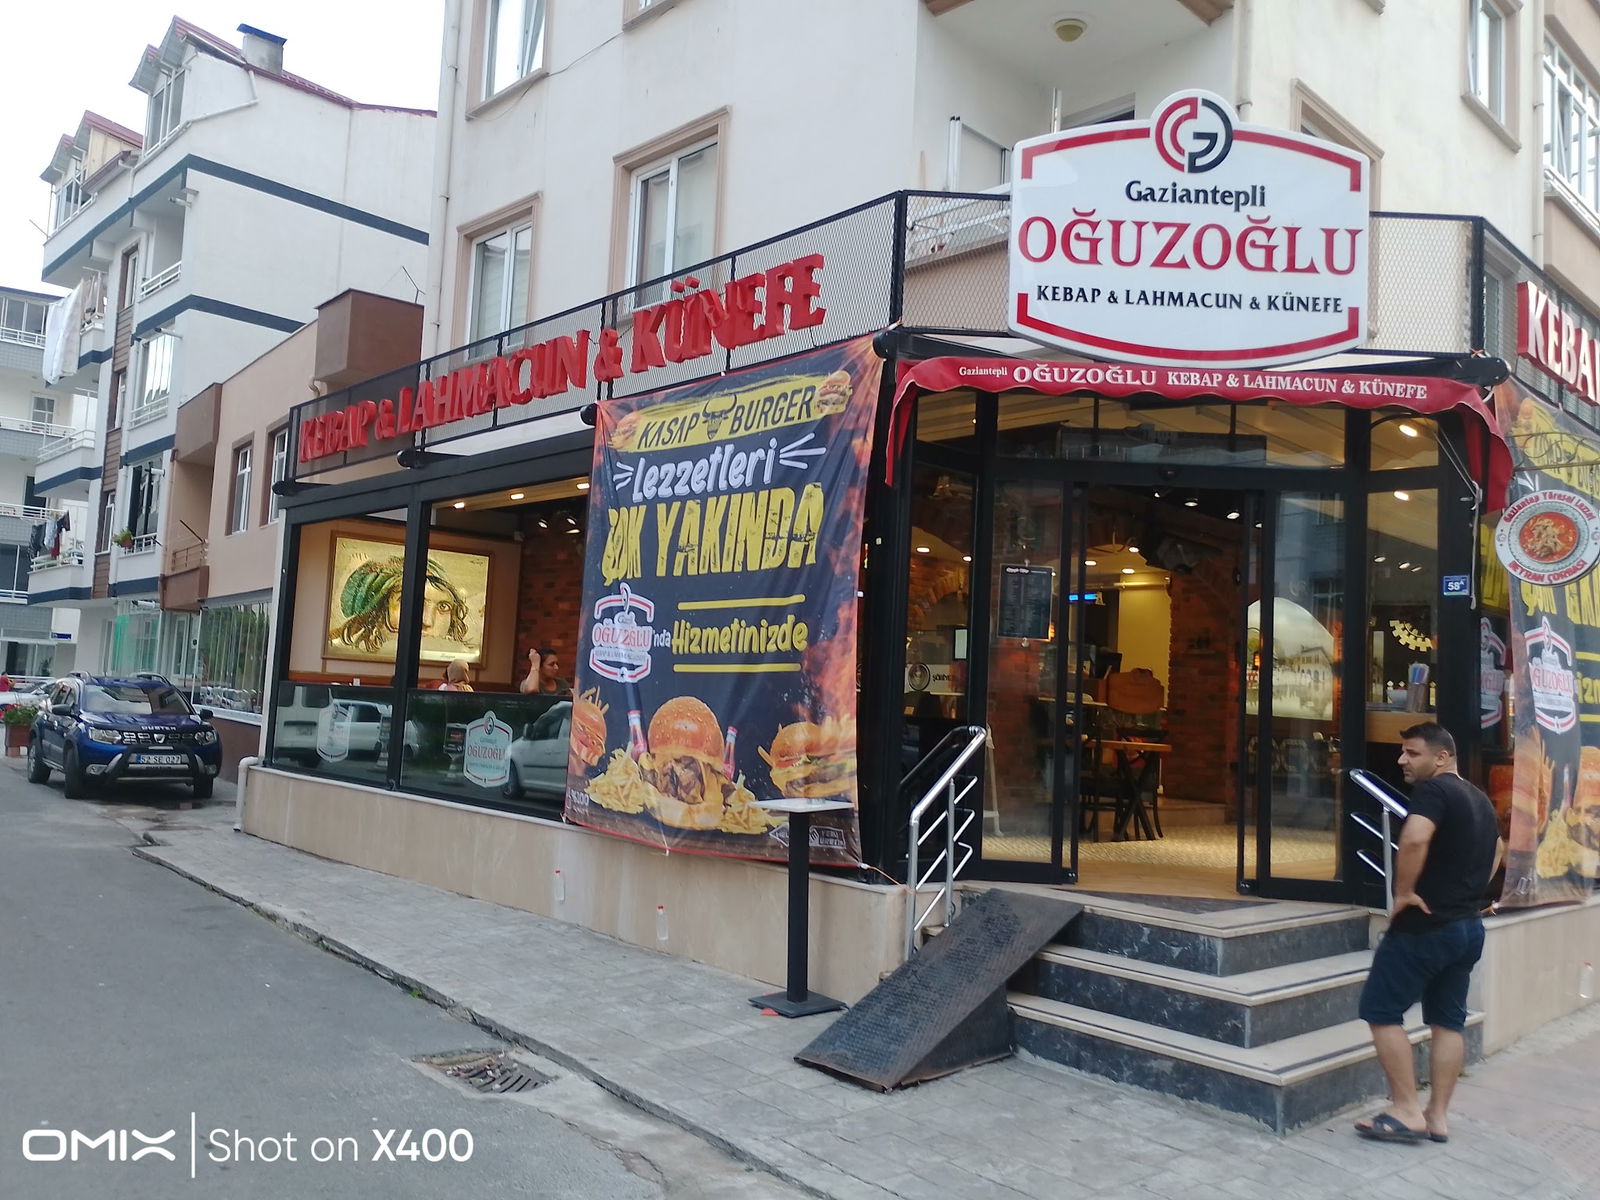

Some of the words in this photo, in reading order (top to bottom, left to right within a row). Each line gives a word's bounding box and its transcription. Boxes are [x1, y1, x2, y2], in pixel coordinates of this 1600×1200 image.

[1125, 180, 1266, 212] Gaziantepli
[1018, 207, 1363, 275] OĞUZOĞLU
[1036, 284, 1102, 304] KEBAP
[1107, 290, 1119, 304] &
[1125, 288, 1242, 310] LAHMACUN
[1249, 296, 1261, 310] &
[1267, 291, 1343, 313] KÜNEFE
[299, 400, 377, 463] KEBAP
[374, 399, 398, 441] &
[397, 329, 590, 434] LAHMACUN
[593, 327, 624, 383] &
[630, 253, 827, 373] KÜNEFE
[1517, 280, 1600, 406] KEBA
[958, 365, 1008, 378] Gaziantepli
[1013, 363, 1157, 386] OĞUZOĞLU
[1167, 371, 1223, 388] KEBAP
[1226, 373, 1240, 388] &
[1244, 374, 1338, 394] LAHMACUN
[1341, 379, 1355, 394] &
[1359, 378, 1427, 400] KÜNEFE
[636, 411, 701, 449] KASAP
[729, 385, 817, 435] BURGER
[655, 481, 825, 578] YAKINDA
[671, 614, 809, 655] Hizmetinizde
